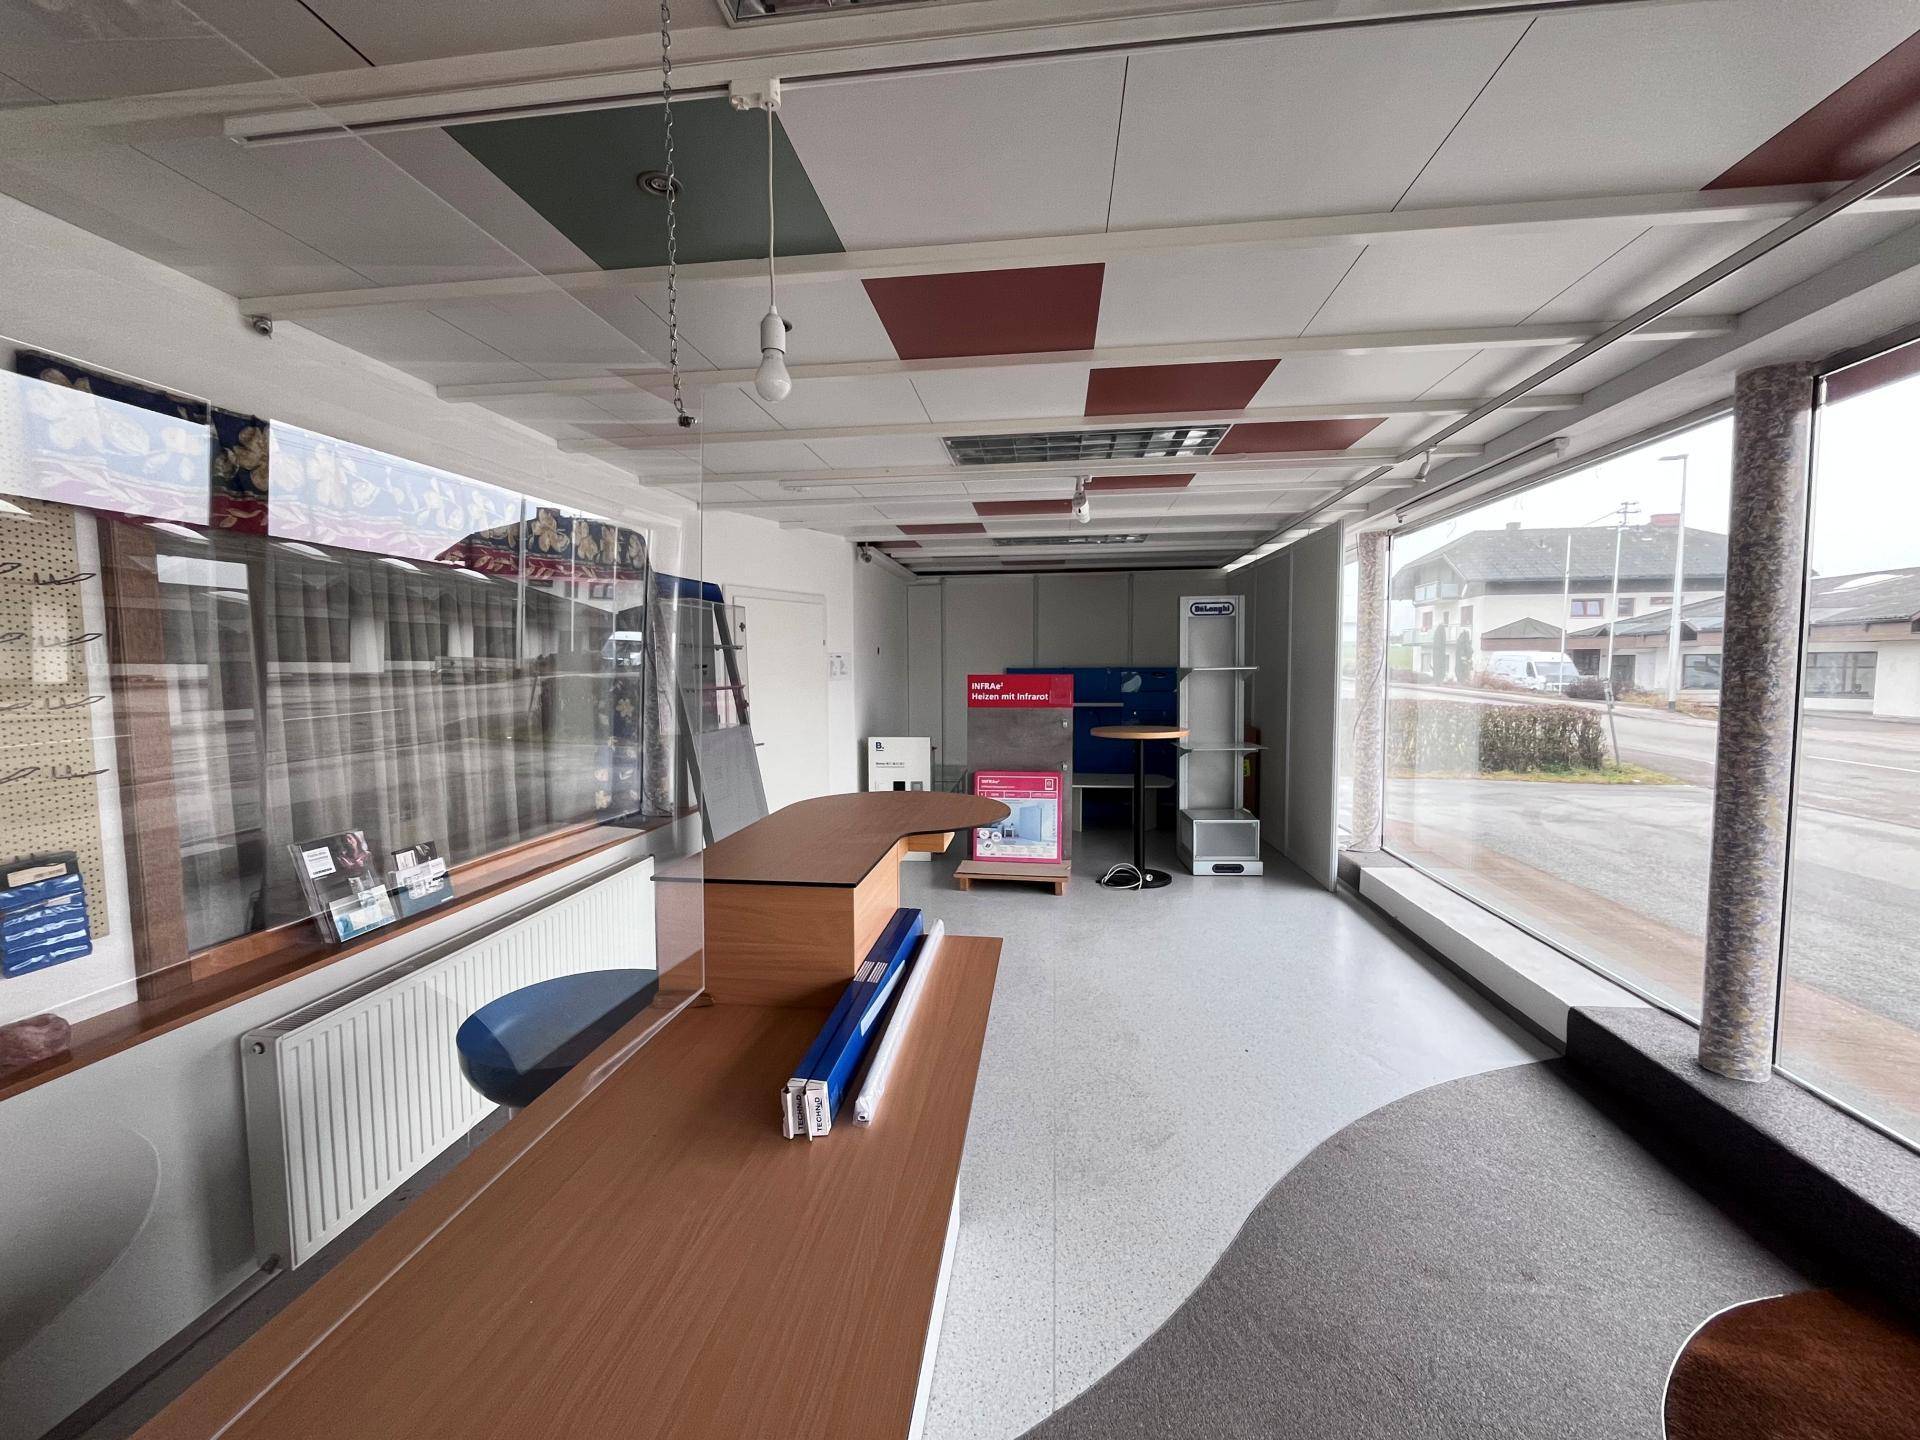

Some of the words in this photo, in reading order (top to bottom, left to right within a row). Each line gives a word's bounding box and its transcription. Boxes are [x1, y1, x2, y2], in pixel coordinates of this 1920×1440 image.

[971, 692, 1000, 701] Heizen
[1001, 692, 1016, 701] mit
[1017, 692, 1049, 701] Infrarot
